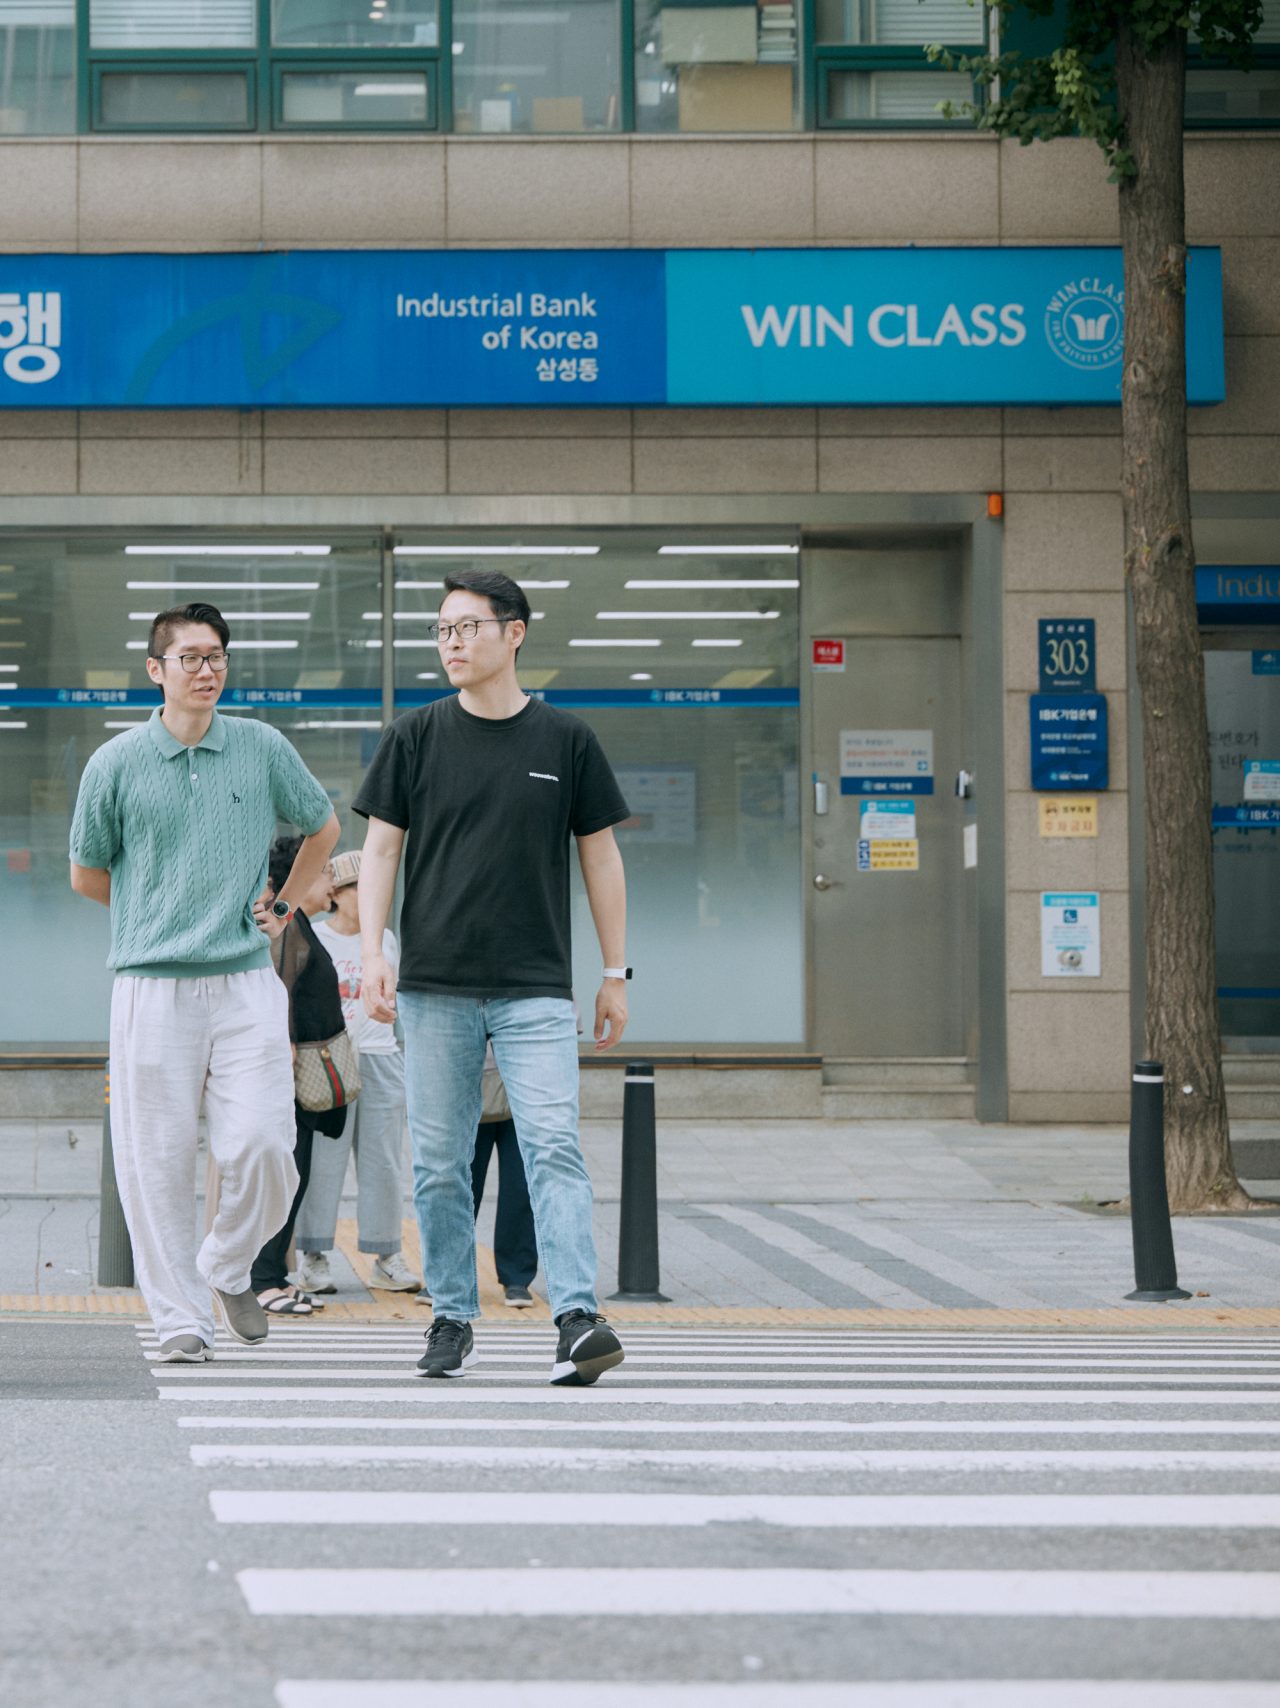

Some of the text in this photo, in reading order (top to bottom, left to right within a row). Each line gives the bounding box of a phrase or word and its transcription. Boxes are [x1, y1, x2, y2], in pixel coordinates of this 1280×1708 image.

[397, 292, 597, 317] Industrial Bank
[482, 324, 599, 350] of Korea
[741, 304, 855, 348] WIN
[867, 303, 1027, 348] CLASS
[536, 357, 599, 382] 삼성동
[1045, 638, 1089, 675] 303
